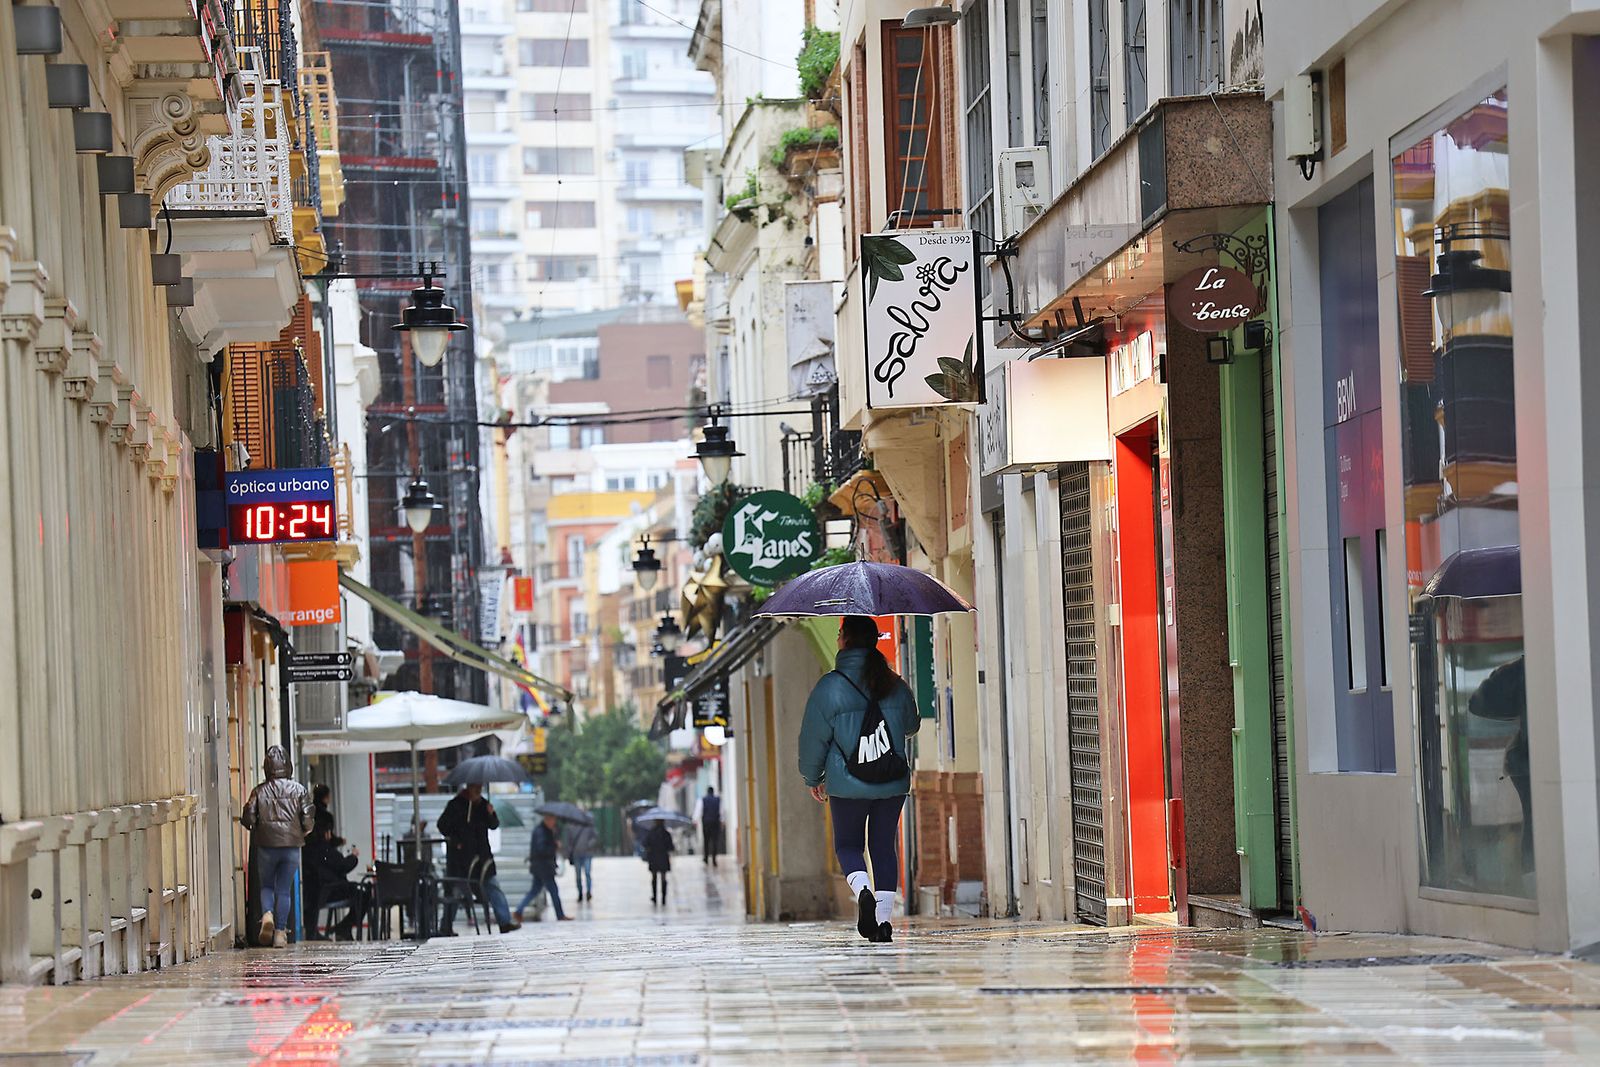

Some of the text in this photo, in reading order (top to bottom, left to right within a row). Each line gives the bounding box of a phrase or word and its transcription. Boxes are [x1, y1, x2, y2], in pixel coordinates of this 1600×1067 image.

[919, 235, 971, 246] Desde 1992
[1195, 268, 1226, 291] La
[1337, 369, 1357, 424] BBVA
[230, 478, 330, 497] óptica urbano
[246, 504, 330, 539] 10:24
[289, 607, 335, 623] range
